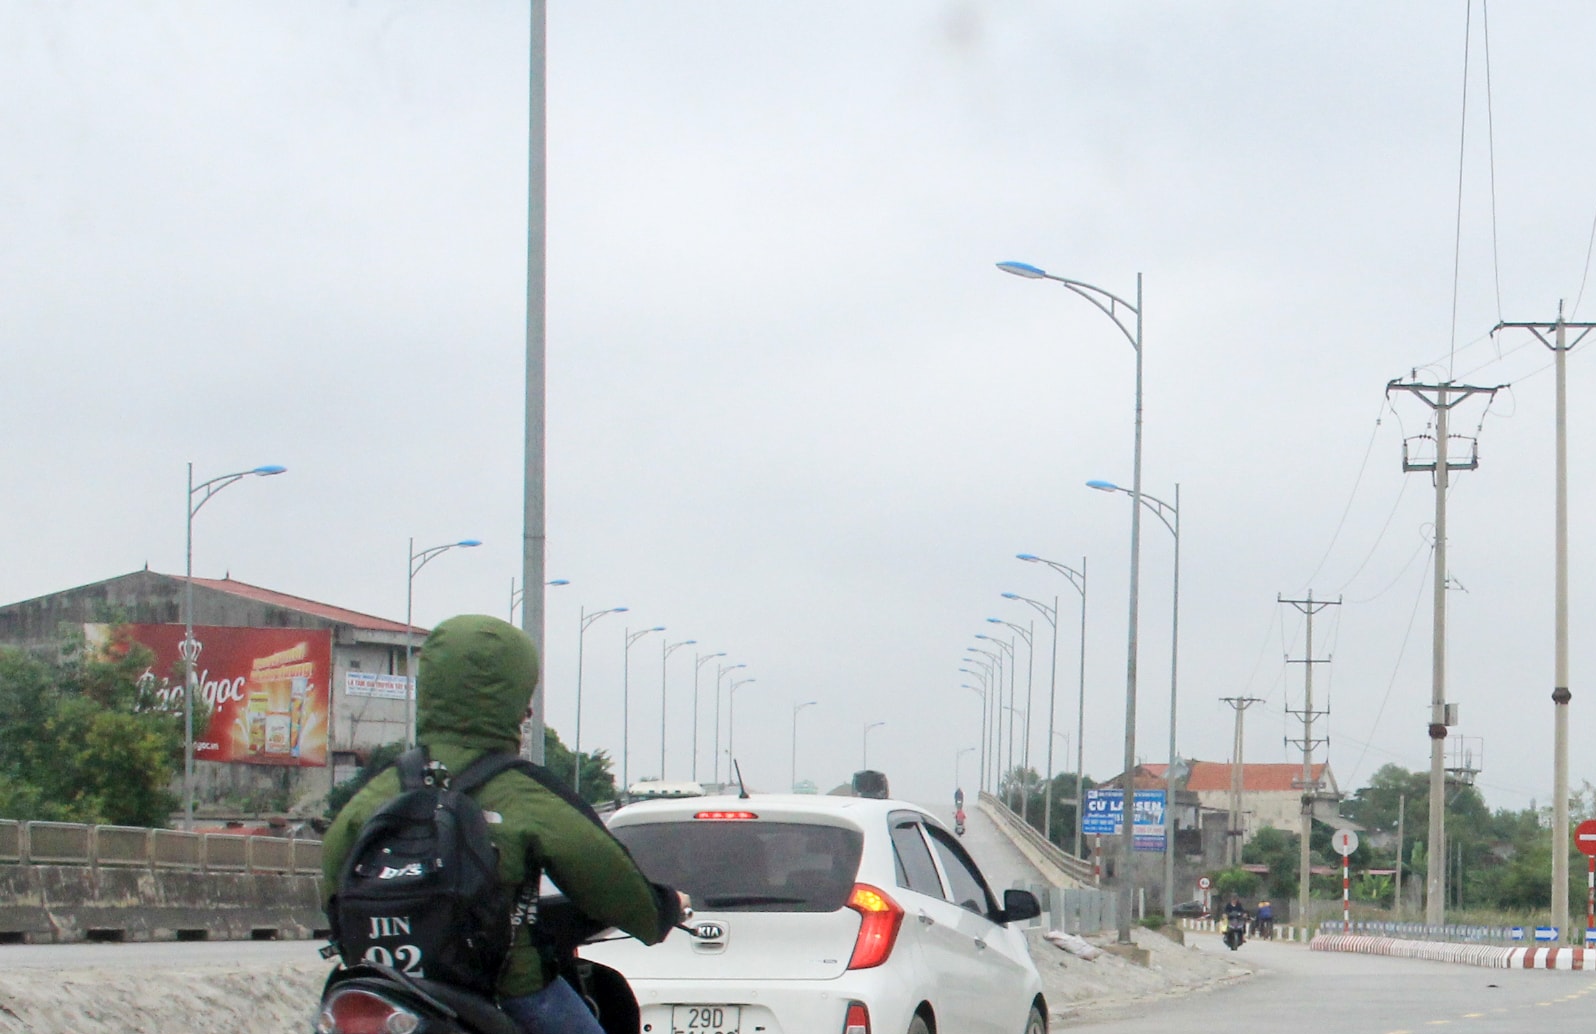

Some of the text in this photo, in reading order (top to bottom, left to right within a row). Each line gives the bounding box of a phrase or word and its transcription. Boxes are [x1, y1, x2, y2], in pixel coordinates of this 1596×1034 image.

[369, 916, 411, 940] JIN
[699, 927, 719, 936] KIA
[689, 1009, 723, 1028] 29D
